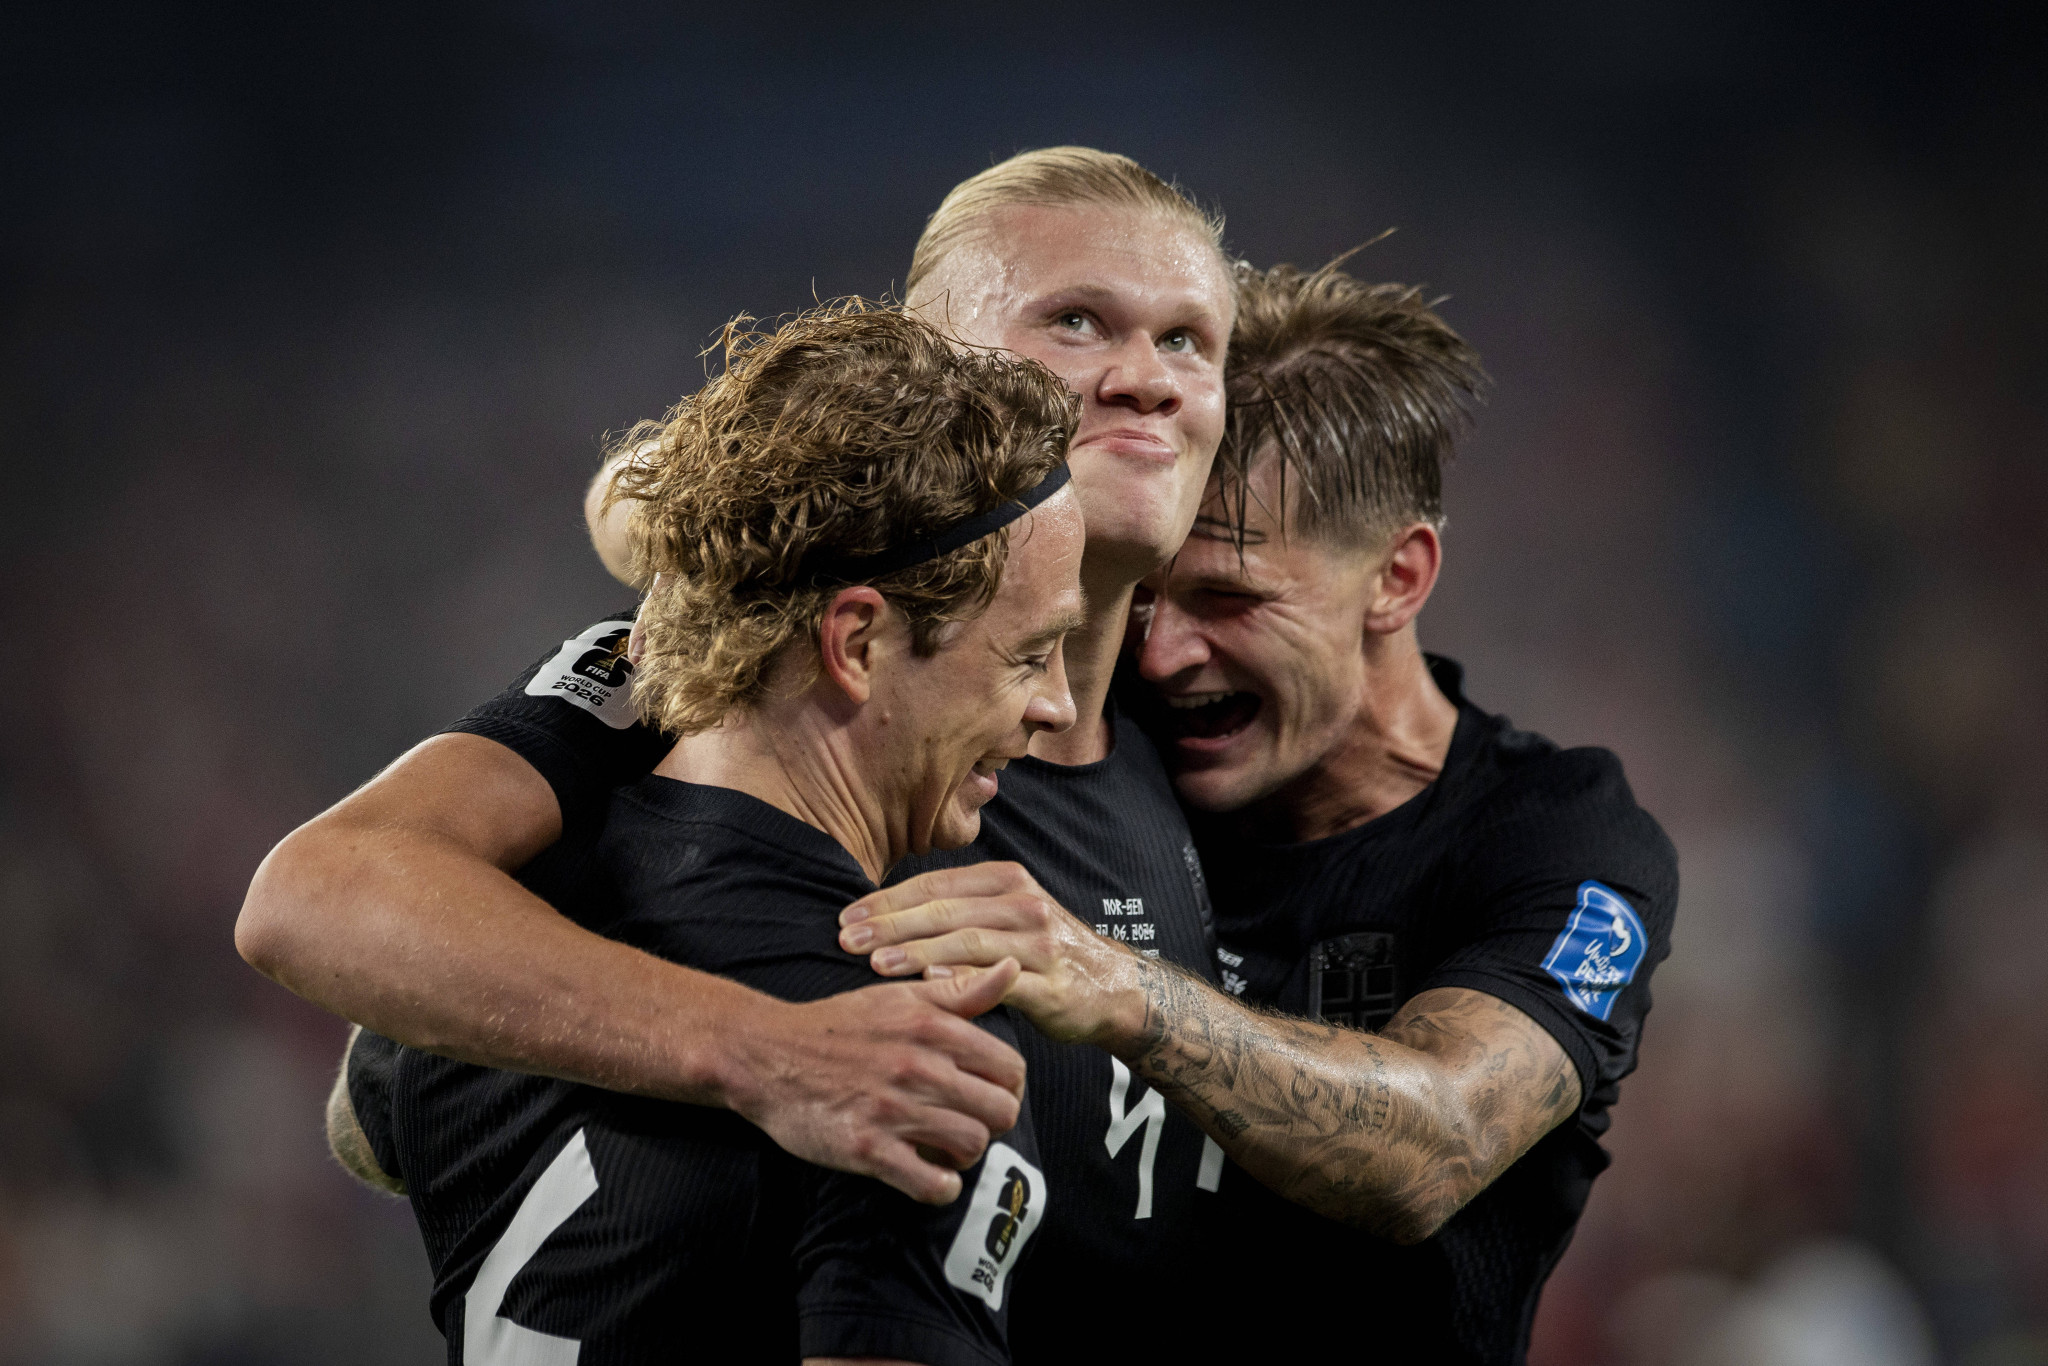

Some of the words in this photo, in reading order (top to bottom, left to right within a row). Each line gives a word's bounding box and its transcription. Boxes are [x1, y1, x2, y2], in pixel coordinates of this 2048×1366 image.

[585, 665, 611, 680] FIFA
[551, 681, 605, 707] 2026
[561, 674, 593, 689] WORLD
[593, 682, 612, 698] CUP
[1103, 898, 1144, 915] NOR-SEN
